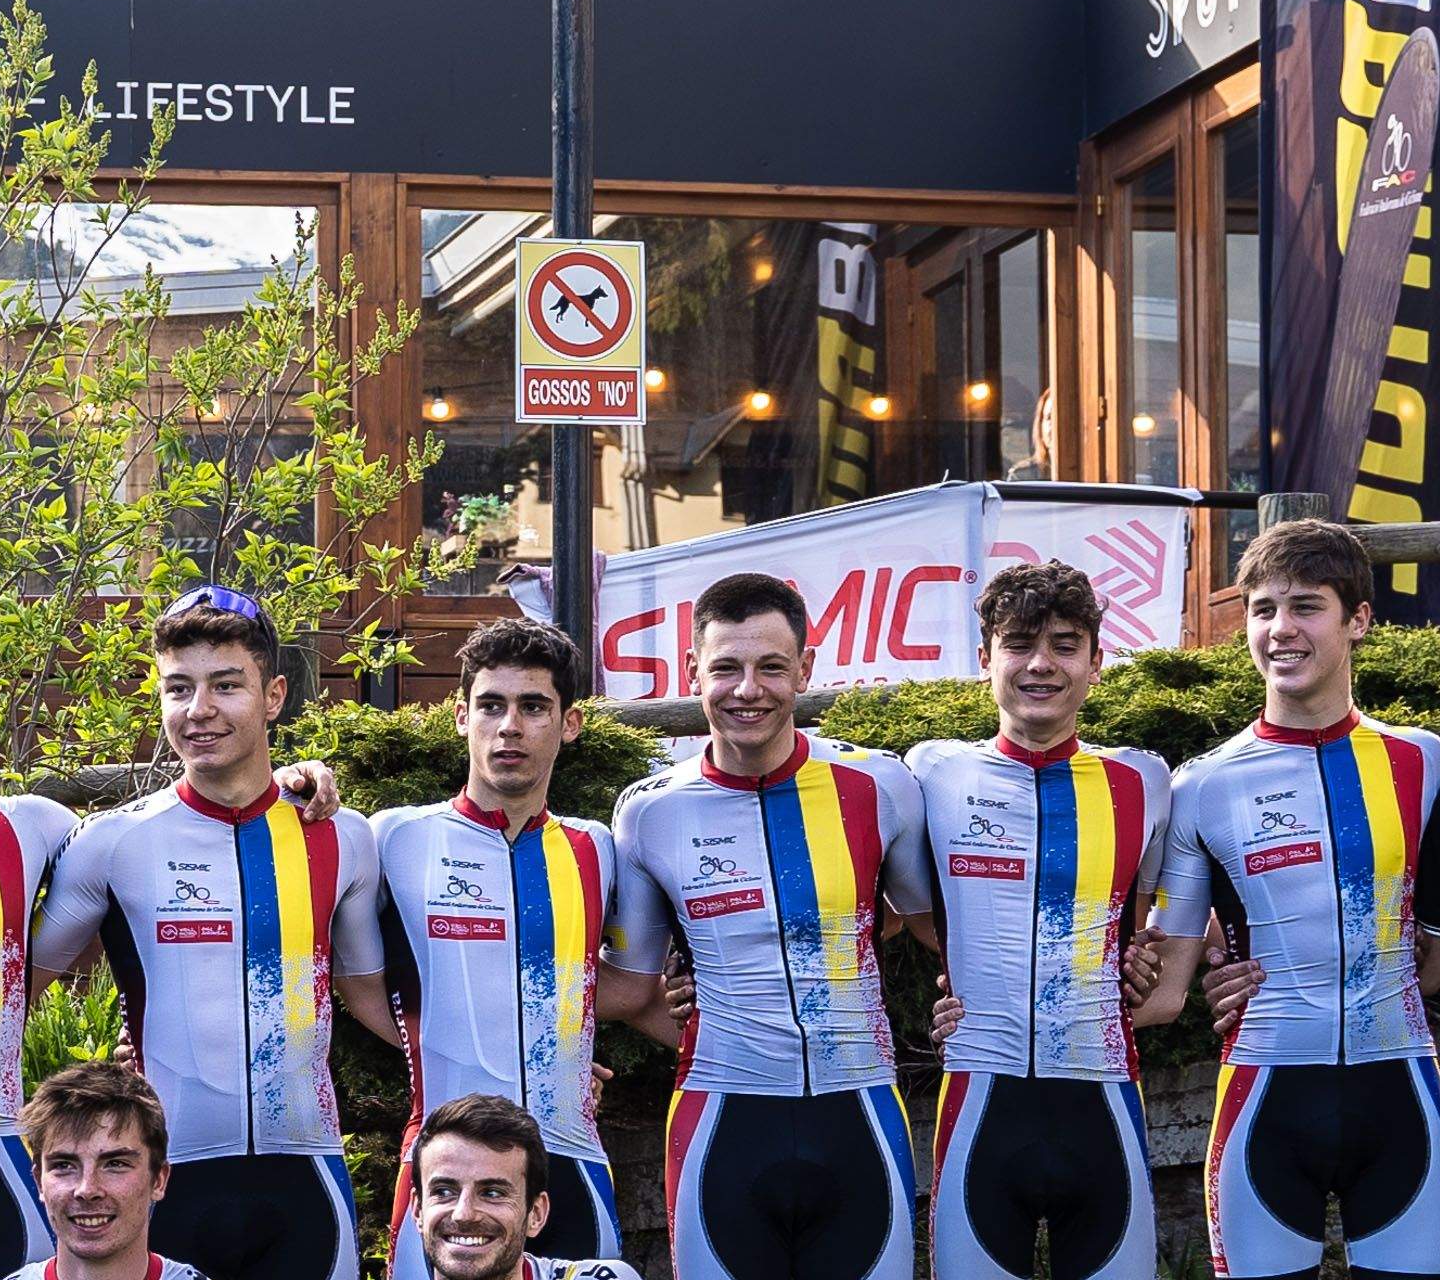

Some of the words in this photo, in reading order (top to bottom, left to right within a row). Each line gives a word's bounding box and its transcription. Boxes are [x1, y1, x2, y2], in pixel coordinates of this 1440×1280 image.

[1372, 170, 1416, 192] FAC
[528, 379, 590, 406] GOSSOS
[976, 799, 1010, 810] SISMIC
[703, 836, 736, 846] SISMIC
